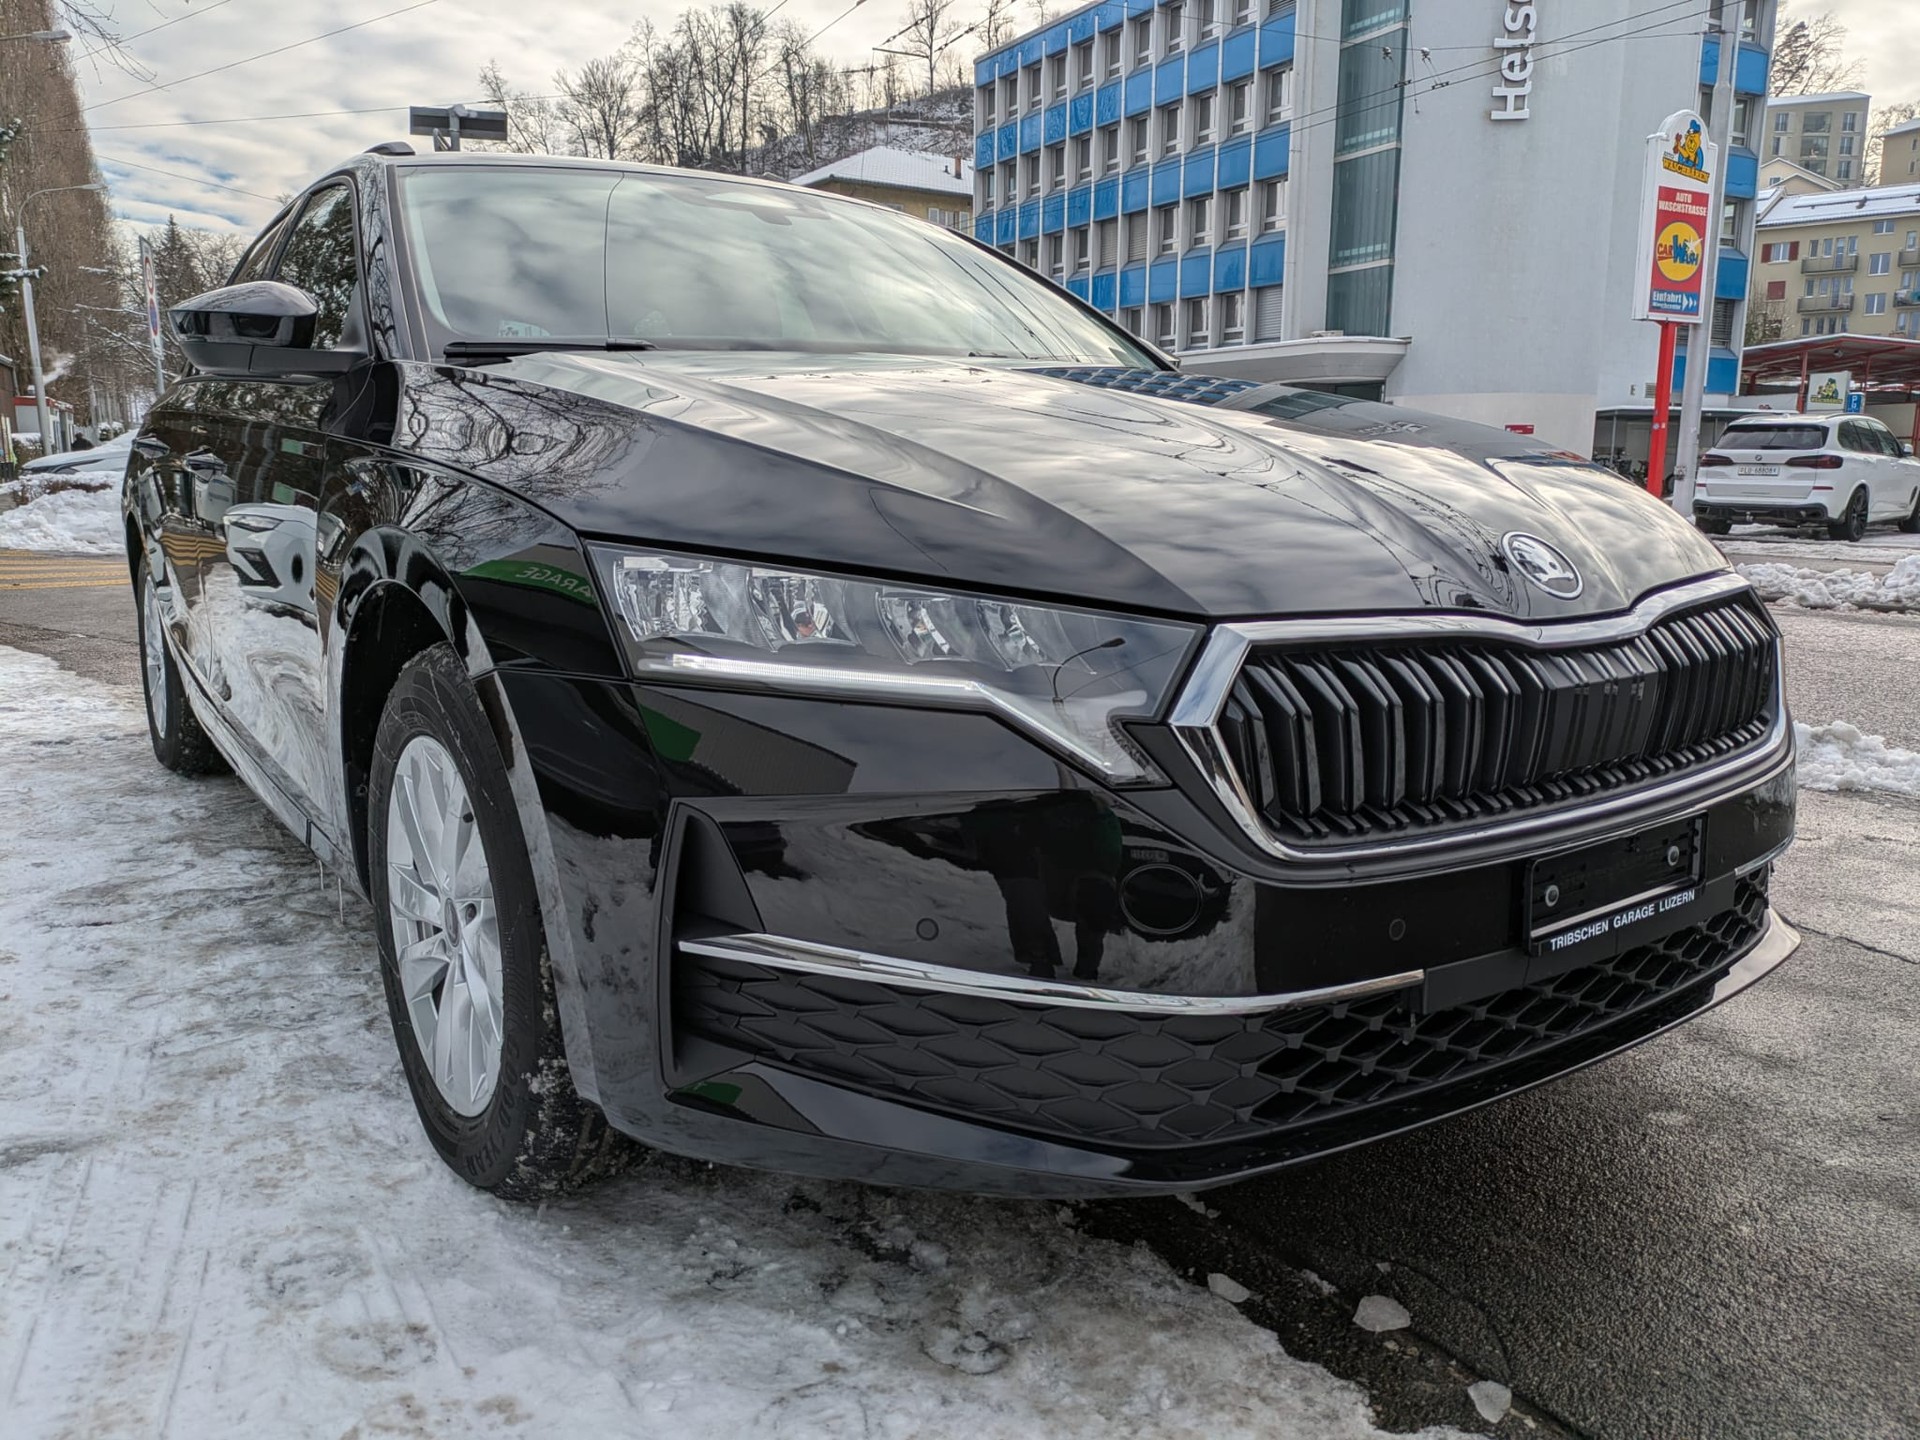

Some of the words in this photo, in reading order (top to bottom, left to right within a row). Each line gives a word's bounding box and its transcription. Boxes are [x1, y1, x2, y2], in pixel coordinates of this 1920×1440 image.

[1490, 0, 1537, 119] Hels
[1675, 192, 1692, 203] AUTO
[1658, 199, 1707, 217] WASCHSTRASSE
[1657, 242, 1673, 256] CAR
[1653, 290, 1682, 303] Einfahrt
[1550, 919, 1609, 951] TRIBSCHEN
[1613, 903, 1655, 929] GARAGE
[1659, 889, 1695, 913] LUZERN
